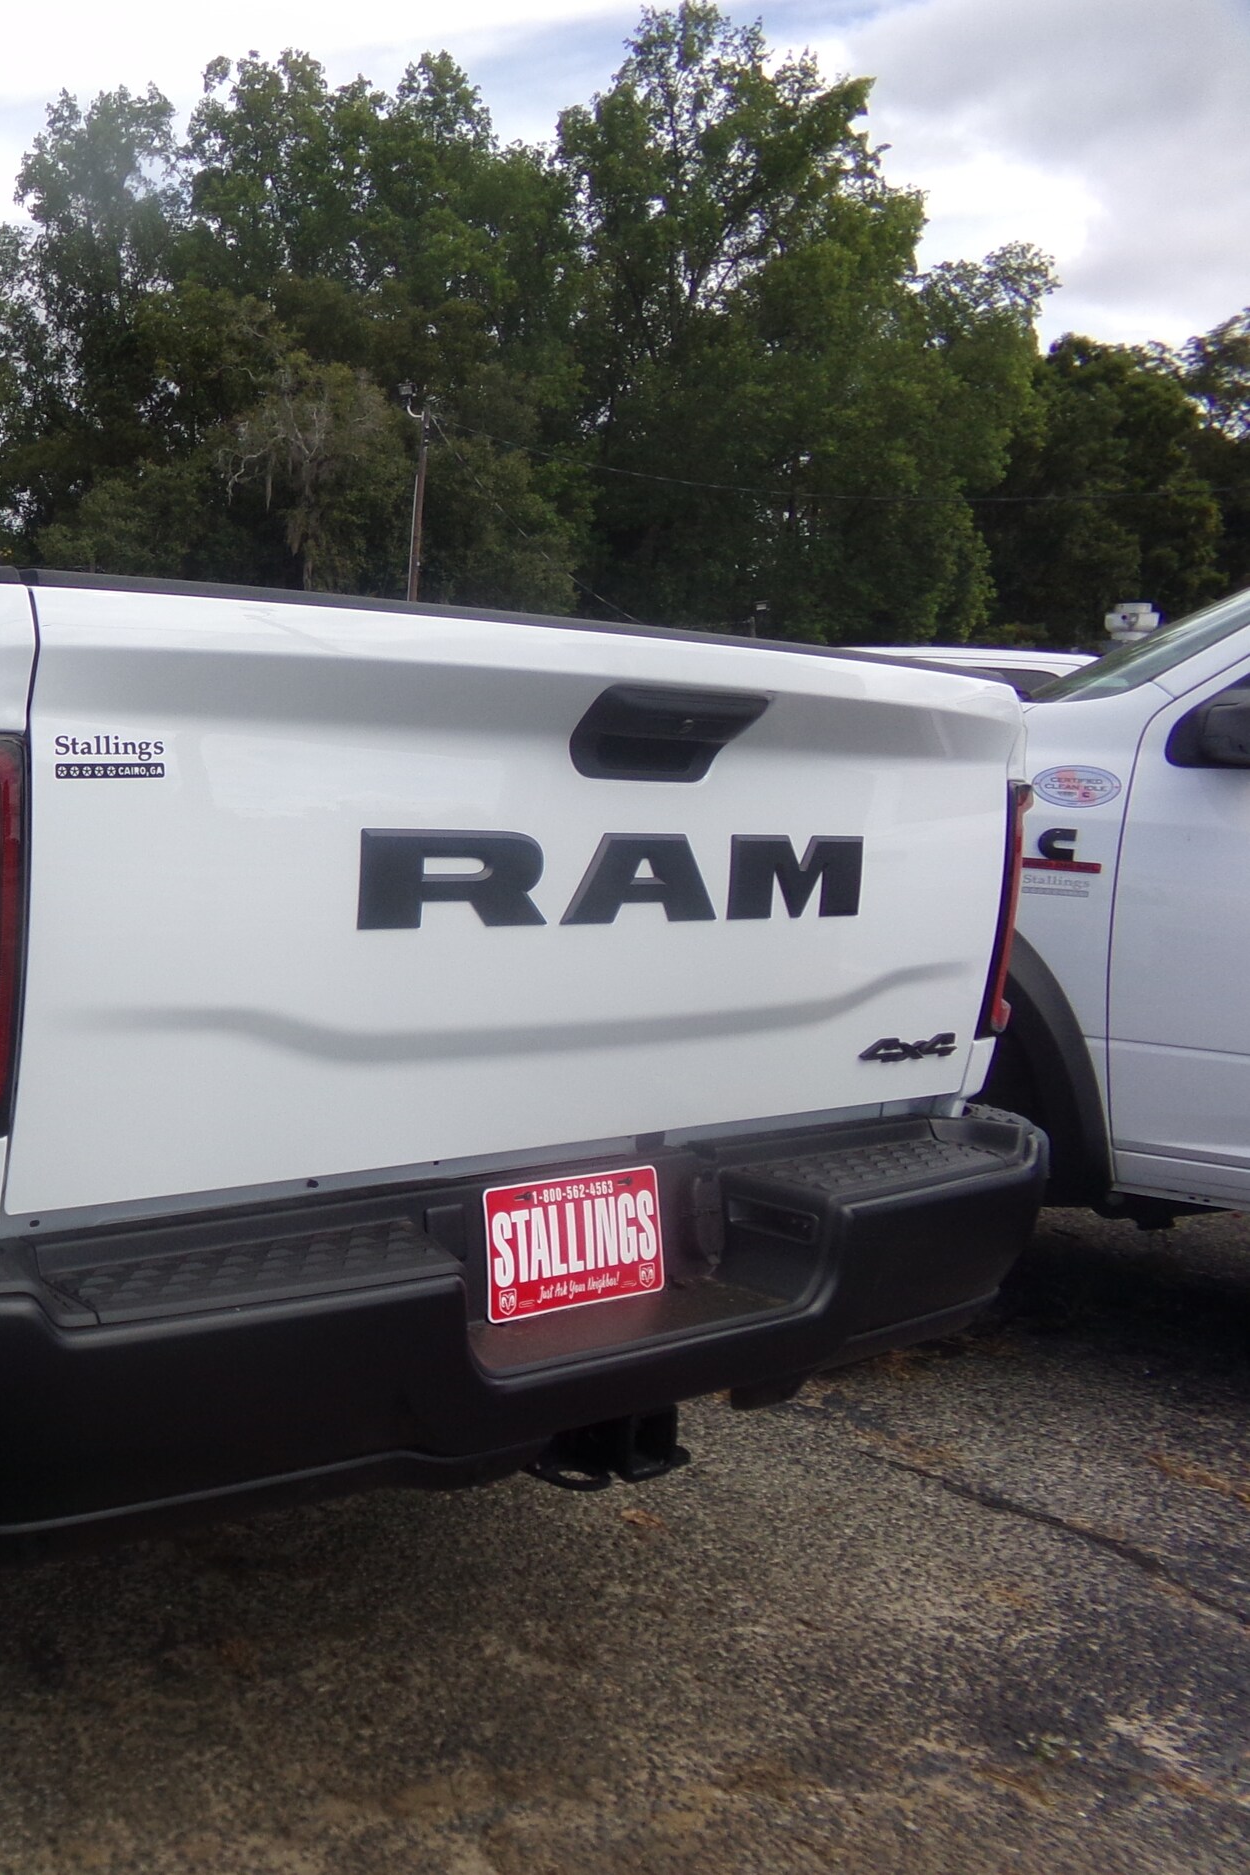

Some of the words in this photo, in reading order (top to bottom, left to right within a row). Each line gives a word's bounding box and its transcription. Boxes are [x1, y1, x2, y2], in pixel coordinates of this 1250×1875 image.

[54, 735, 164, 761] Stallings
[1044, 783, 1080, 791] CLEAN
[1050, 777, 1103, 785] CERTIFIED
[357, 827, 864, 930] RAM
[1022, 874, 1091, 891] Stallings
[858, 1032, 958, 1063] 4x4
[532, 1180, 614, 1205] 1-800-562-4563
[491, 1189, 657, 1288] STALLINGS
[536, 1285, 554, 1304] Just
[554, 1280, 568, 1297] Ask
[568, 1279, 586, 1300] Your
[586, 1271, 620, 1294] Neighbor!
